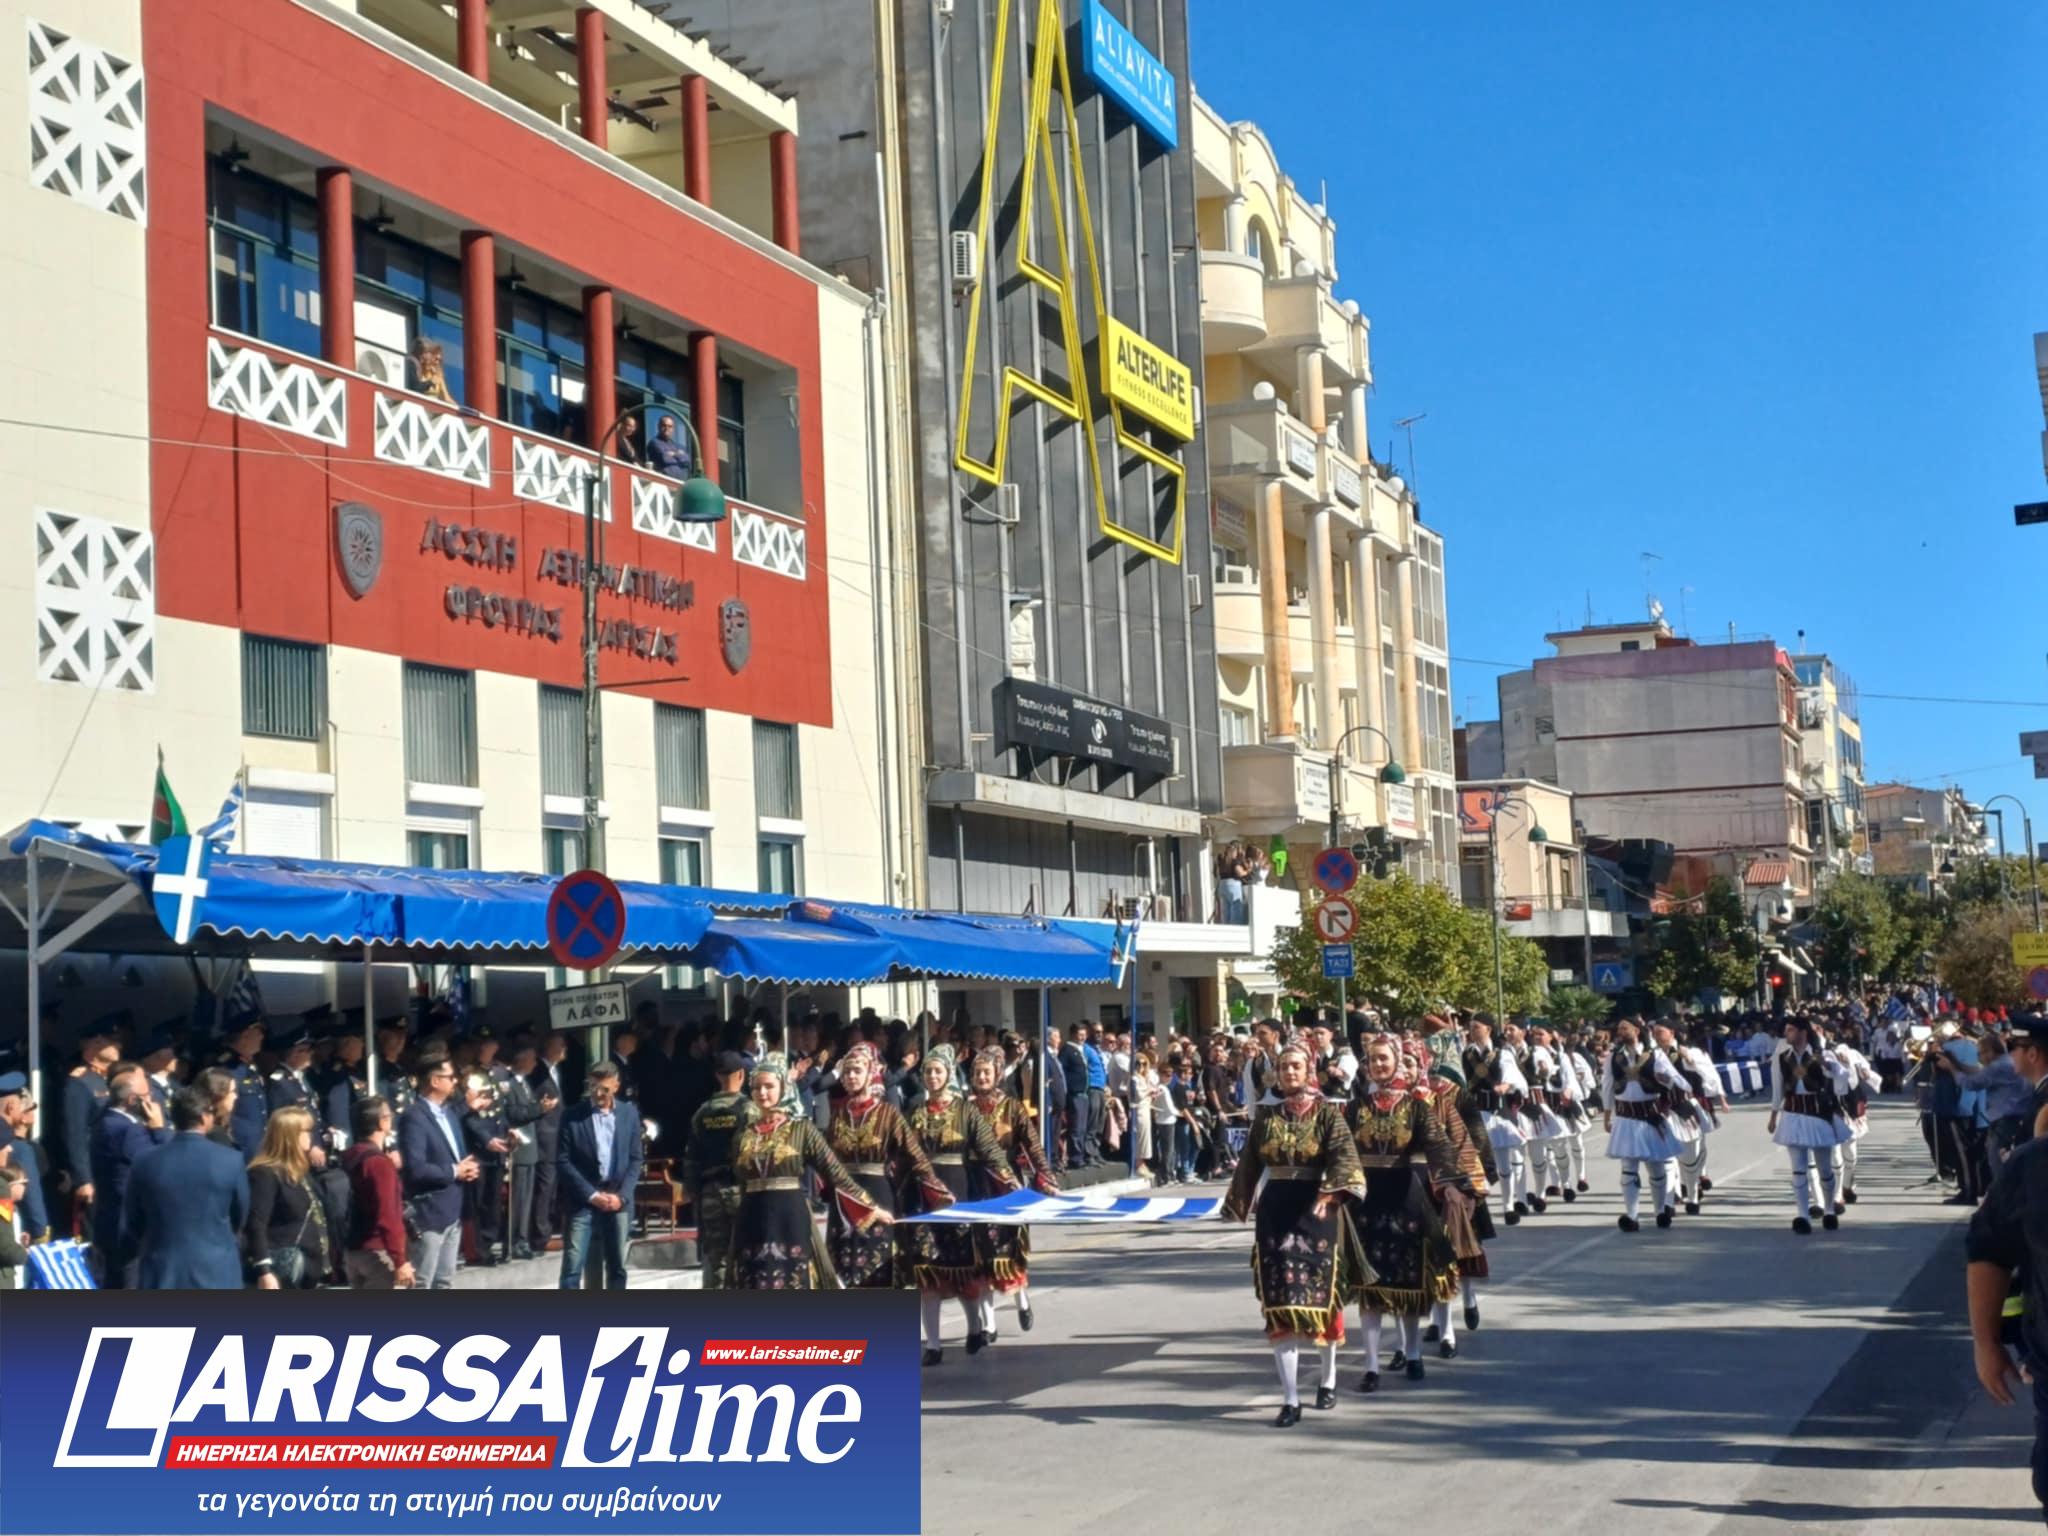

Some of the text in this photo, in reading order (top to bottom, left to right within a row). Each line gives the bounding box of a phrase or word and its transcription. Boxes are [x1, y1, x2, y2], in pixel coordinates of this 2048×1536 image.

[1095, 15, 1172, 112] ALIAVITA
[1117, 373, 1187, 424] FITNESS EXCELLENCE
[1118, 336, 1186, 406] ALTERLIFE
[444, 585, 679, 667] ΦΡΟΥΡΑΣ ΑΡΙΣΑΣ
